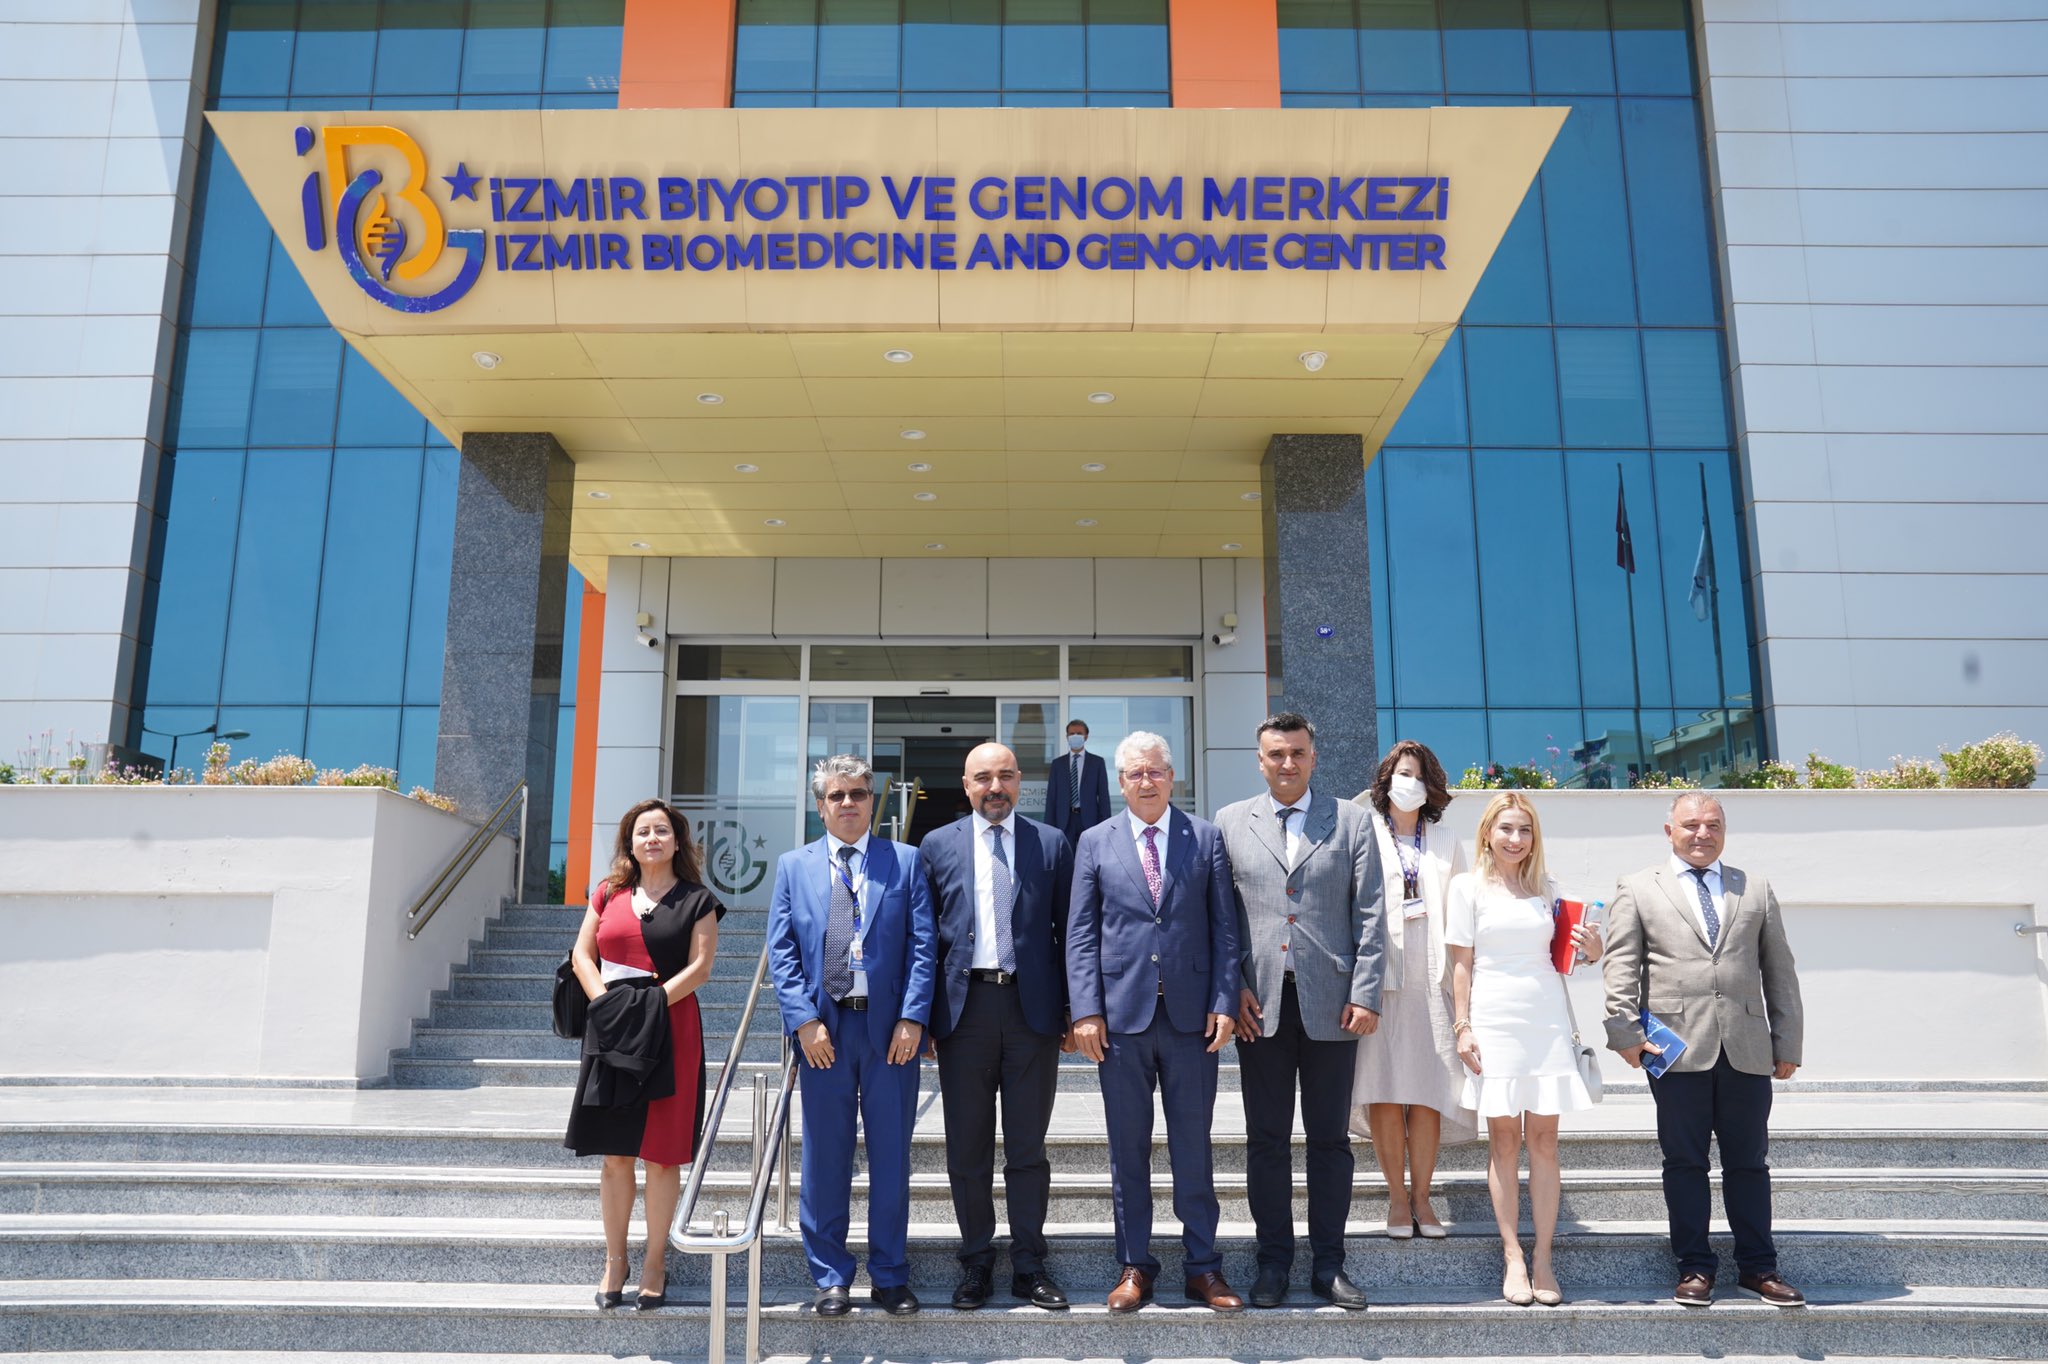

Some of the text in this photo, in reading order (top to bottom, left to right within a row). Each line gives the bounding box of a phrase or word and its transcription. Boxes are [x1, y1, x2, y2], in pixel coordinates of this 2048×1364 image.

[881, 176, 956, 221] VE
[969, 176, 1182, 221] GENOM
[495, 232, 1447, 271] IZMIR BIOMEDICINE AND GENOME CENTER
